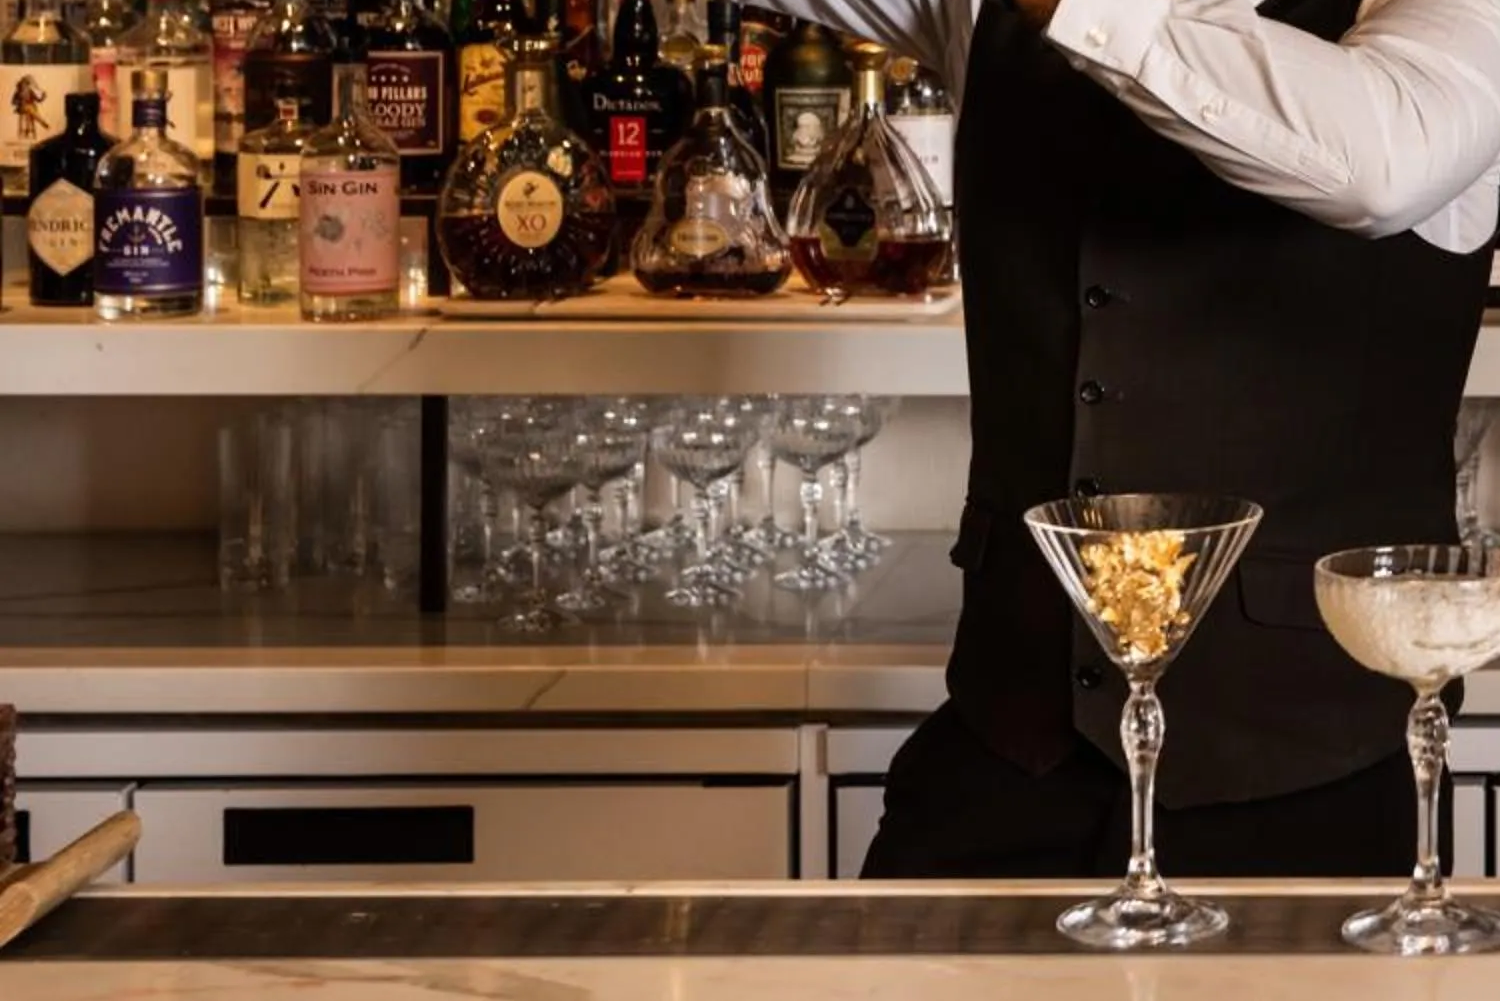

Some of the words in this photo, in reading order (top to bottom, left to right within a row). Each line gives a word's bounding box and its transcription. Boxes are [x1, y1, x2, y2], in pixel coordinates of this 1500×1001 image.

[381, 86, 427, 100] PILLARS
[367, 102, 426, 117] LOODY
[617, 121, 640, 146] 12
[342, 181, 378, 196] GIN
[31, 218, 91, 233] ENDRIC
[99, 206, 183, 253] FREMANTLE
[516, 213, 547, 232] XO
[123, 245, 149, 257] GIN
